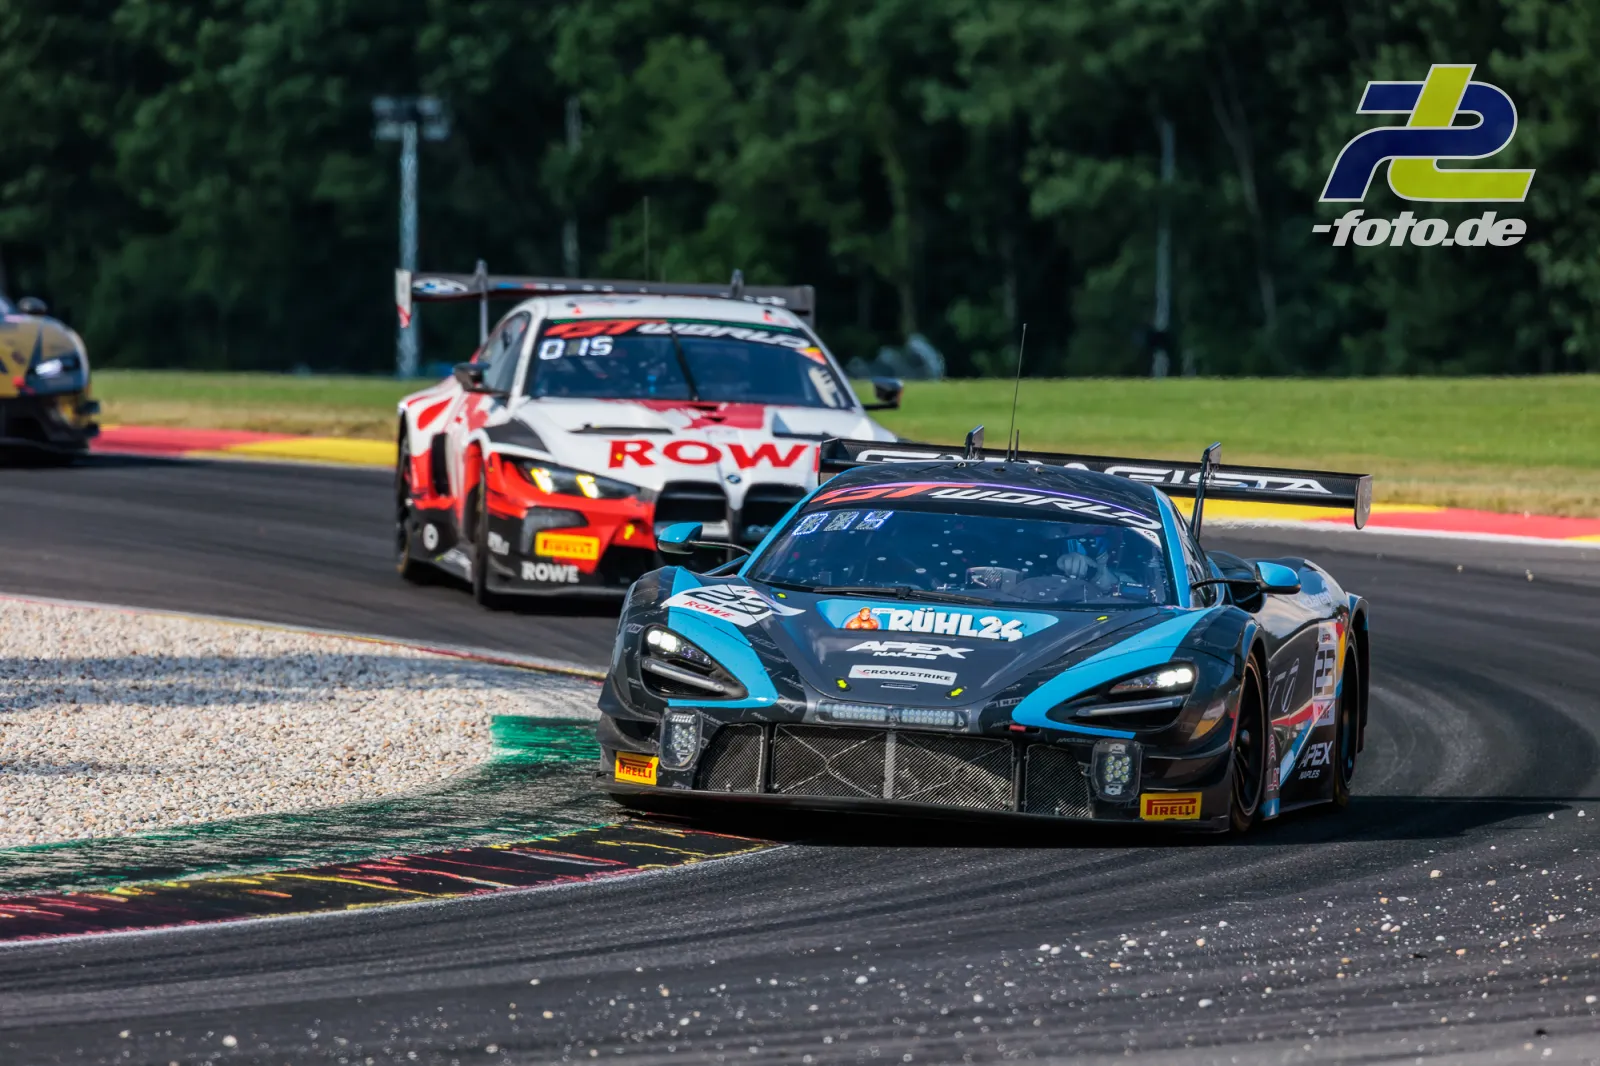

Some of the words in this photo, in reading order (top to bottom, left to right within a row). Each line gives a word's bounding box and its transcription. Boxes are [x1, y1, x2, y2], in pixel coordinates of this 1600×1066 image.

[608, 440, 820, 472] ROW
[809, 483, 978, 505] GT
[928, 488, 1163, 530] WORLD
[521, 561, 580, 583] ROWE
[683, 600, 736, 619] ROWE
[887, 608, 1025, 642] RÜHL24
[846, 640, 975, 659] APEX
[872, 651, 938, 660] NAPLES
[861, 668, 952, 682] CROWDSTRIKE
[1297, 741, 1334, 769] APEX
[618, 757, 653, 779] PIRELLI
[1146, 798, 1197, 816] PIRELLI
